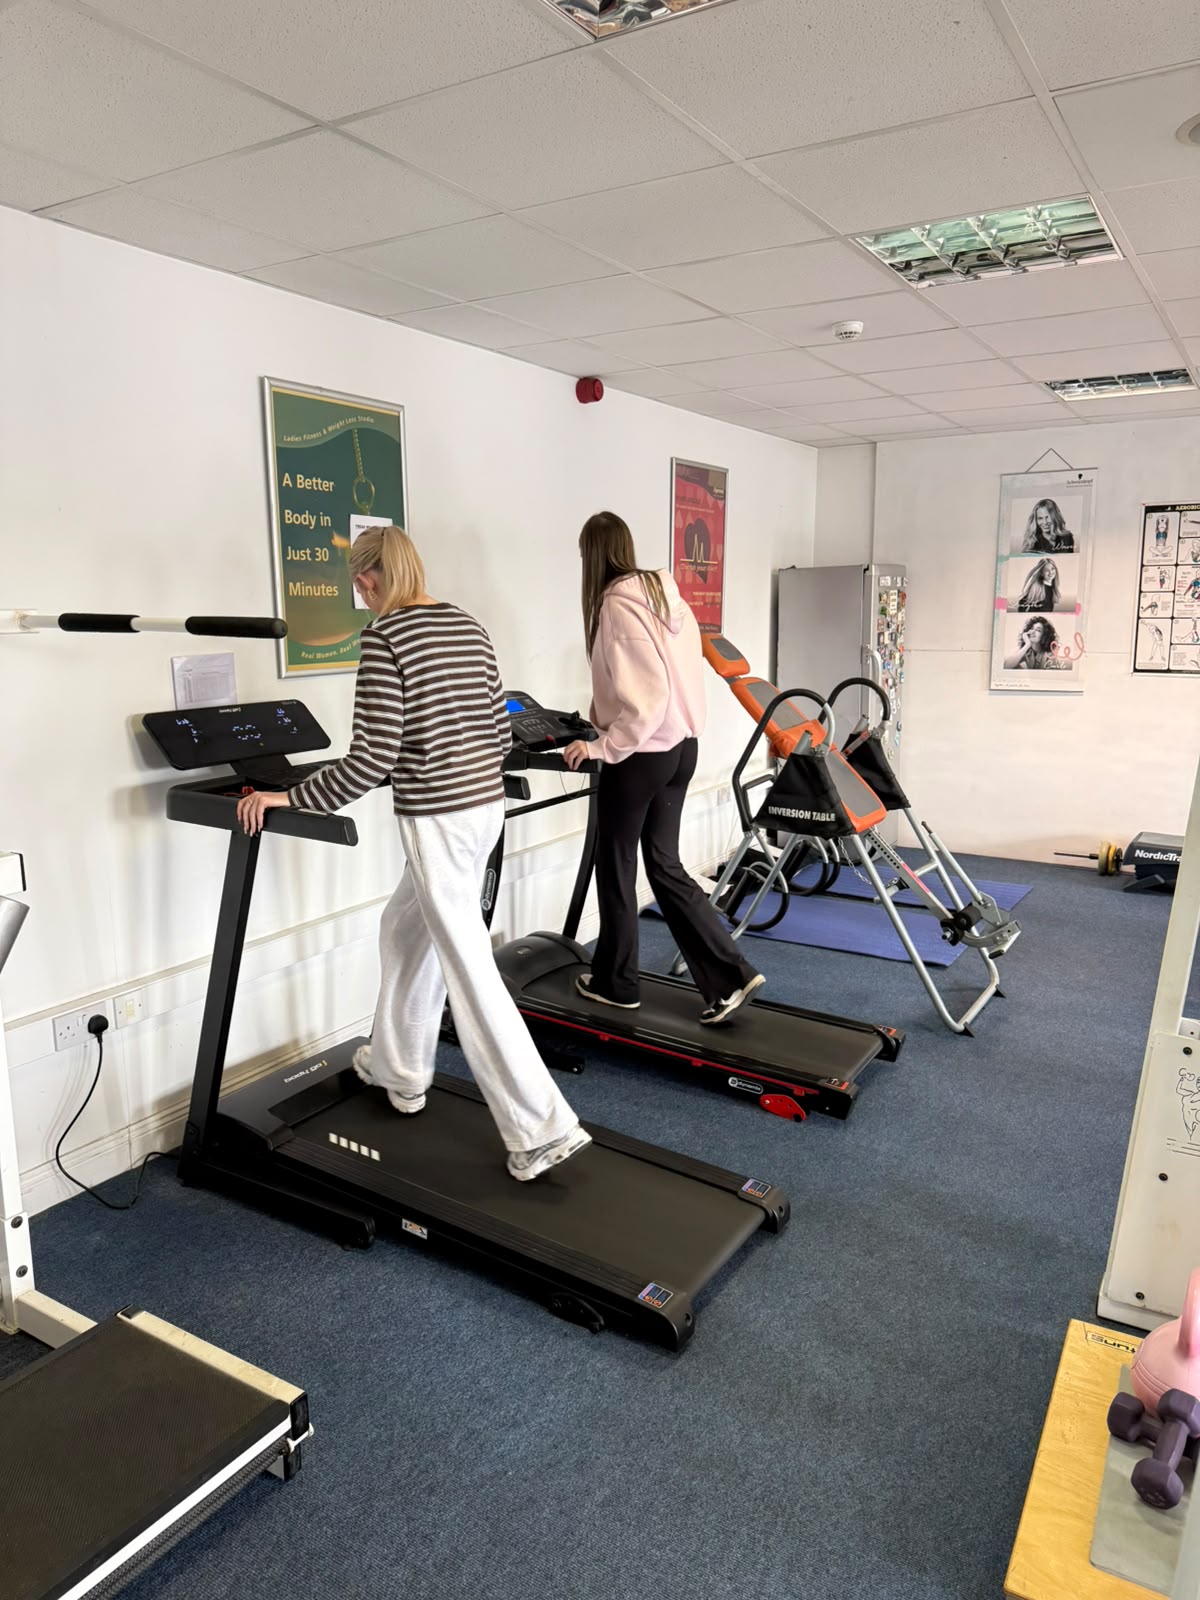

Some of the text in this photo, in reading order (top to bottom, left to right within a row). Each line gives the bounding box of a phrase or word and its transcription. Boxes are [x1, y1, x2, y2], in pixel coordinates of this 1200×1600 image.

[283, 434, 302, 442] Ladies
[303, 431, 322, 441] Fitness
[327, 419, 345, 433] Weight
[345, 416, 357, 424] Loss
[357, 415, 375, 423] Studio
[282, 472, 335, 492] A Better
[284, 509, 332, 529] Body in
[286, 545, 329, 562] Just 30
[288, 581, 339, 597] Minutes
[301, 651, 314, 659] Real
[768, 806, 836, 822] INVERSION TABLE
[283, 1069, 310, 1083] body
